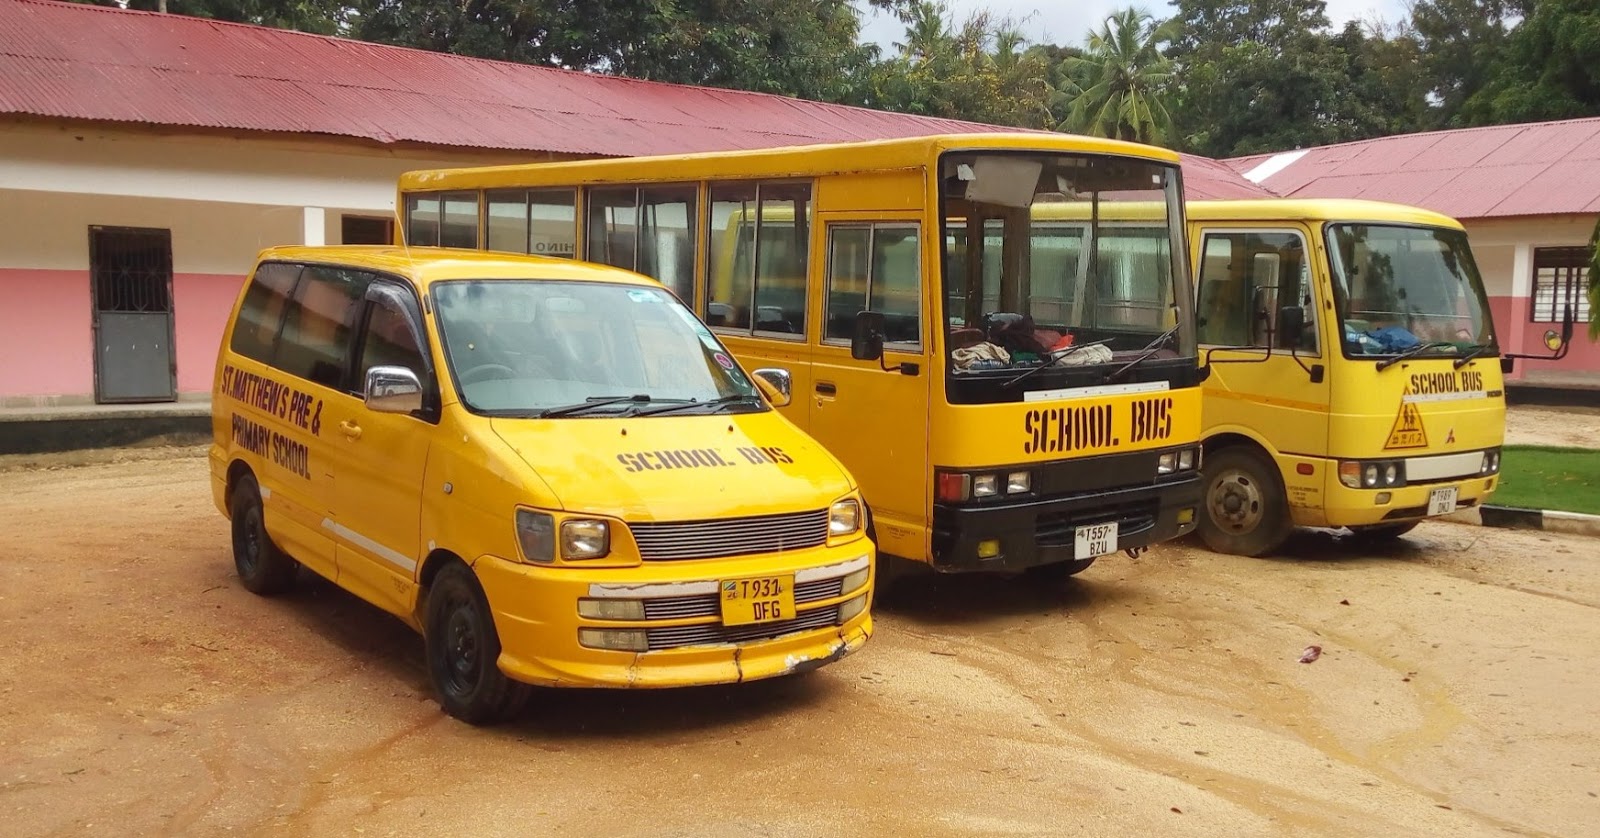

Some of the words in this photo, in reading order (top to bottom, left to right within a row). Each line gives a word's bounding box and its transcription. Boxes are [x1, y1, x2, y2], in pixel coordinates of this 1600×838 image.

[1410, 372, 1459, 395] SCHOOL
[1461, 371, 1483, 392] BUS
[289, 389, 313, 429] PRE
[311, 399, 323, 437] &
[1024, 404, 1119, 454] SCHOOL
[1130, 397, 1173, 442] BUS
[232, 412, 271, 460] PRIMARY
[273, 432, 311, 481] SCHOOL
[616, 448, 736, 472] SCHOOL
[736, 446, 794, 465] BUS
[1090, 540, 1107, 555] BZU
[741, 580, 750, 599] T
[753, 600, 780, 620] DFG
